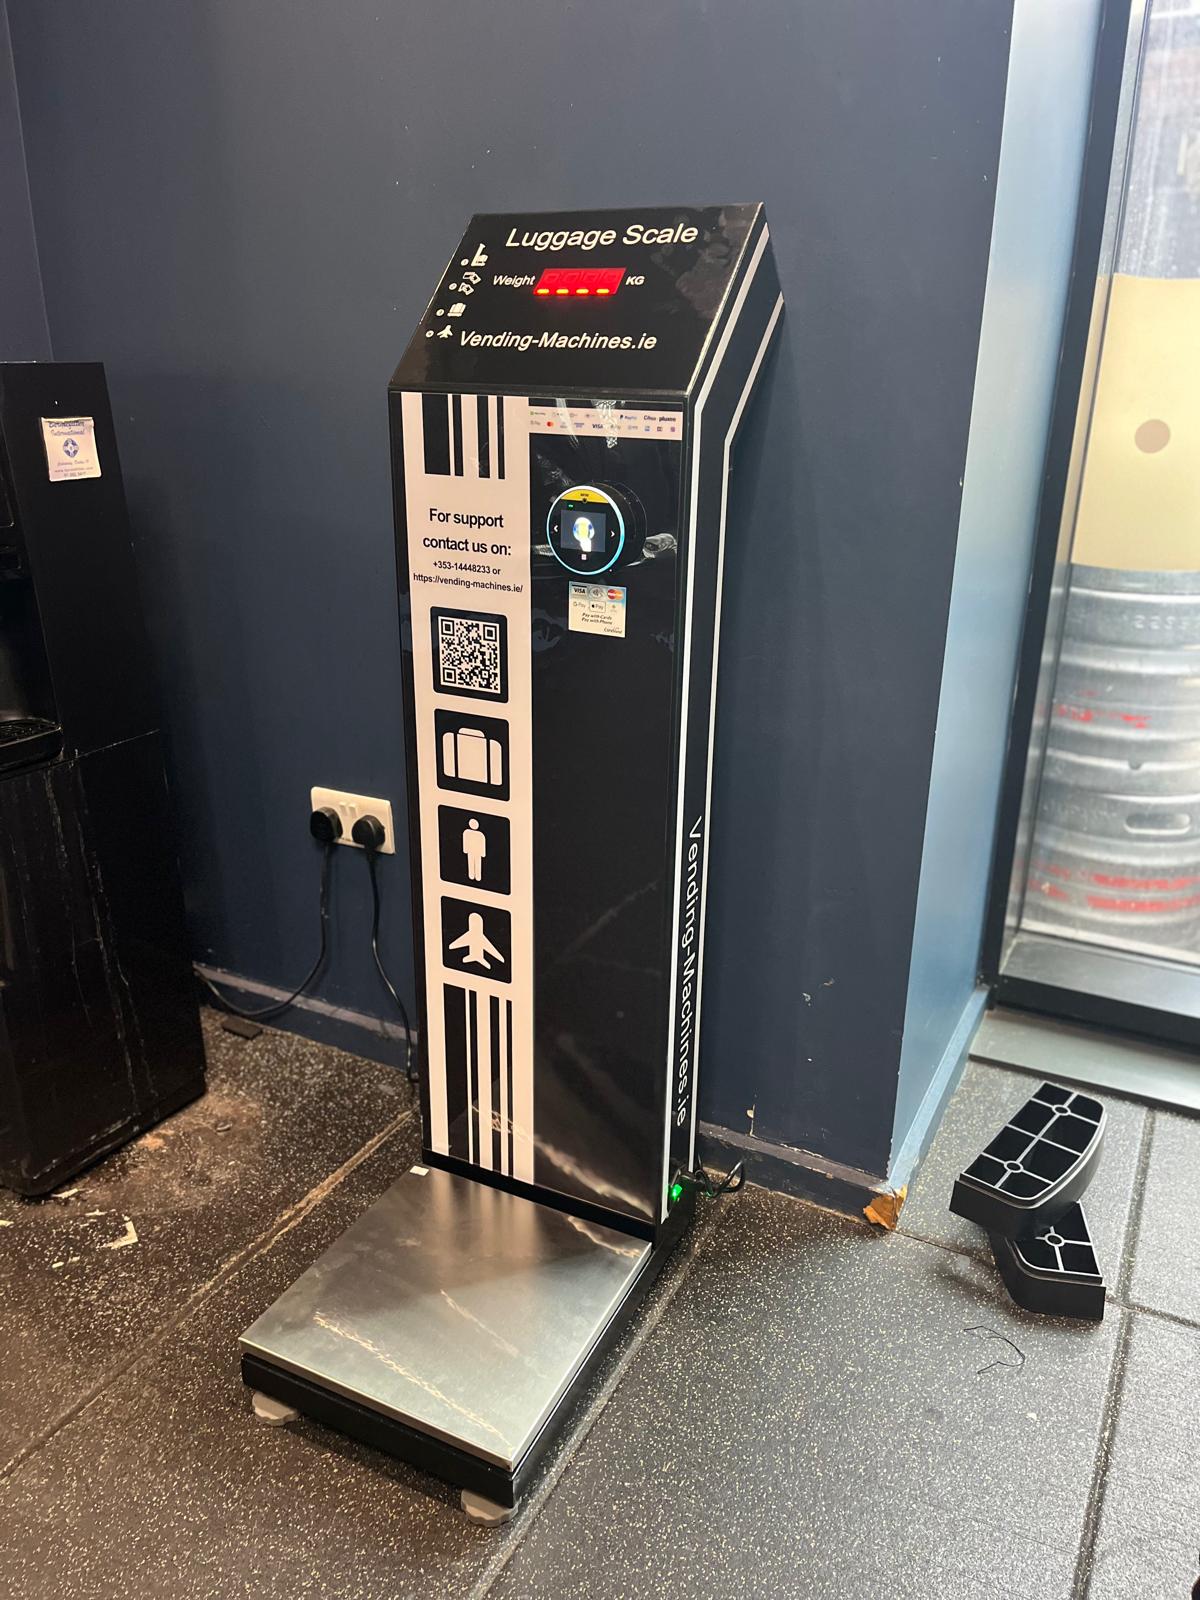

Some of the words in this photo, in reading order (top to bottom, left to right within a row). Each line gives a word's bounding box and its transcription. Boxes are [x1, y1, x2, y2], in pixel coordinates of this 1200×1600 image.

[505, 227, 616, 251] Luggage
[622, 223, 699, 245] Scale
[493, 274, 537, 288] Weight
[625, 276, 645, 286] KG
[460, 330, 657, 351] Vending-Machines.ie
[429, 508, 451, 523] For
[453, 513, 504, 529] support
[423, 537, 469, 552] contact
[472, 542, 488, 554] us
[491, 543, 512, 556] on:
[433, 560, 491, 574] +353-14448233
[492, 567, 501, 575] or
[413, 573, 523, 593] https://vending-machines.ie/
[676, 815, 702, 1127] Vending-Machines.ie
